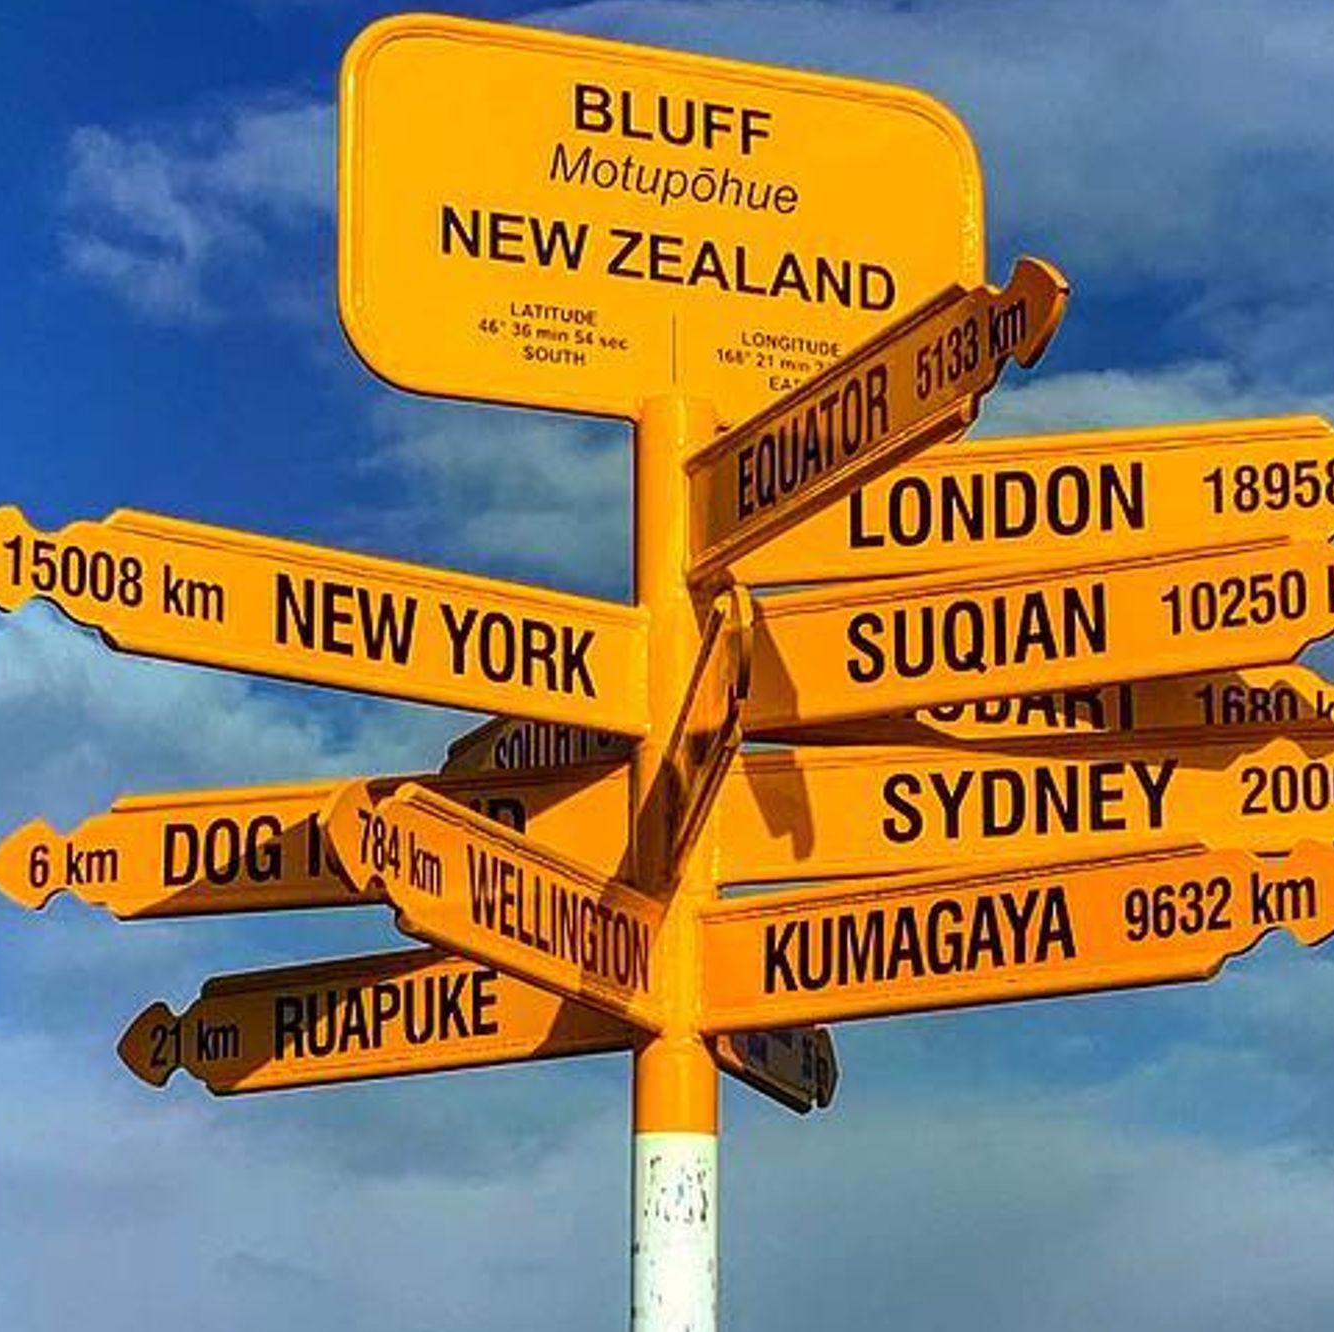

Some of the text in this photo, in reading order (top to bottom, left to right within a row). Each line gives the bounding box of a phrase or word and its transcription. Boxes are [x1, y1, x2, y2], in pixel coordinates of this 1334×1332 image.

[574, 83, 772, 155] BLUFF
[549, 142, 800, 215] Motupōhue
[440, 206, 897, 311] NEW ZEALAND
[510, 302, 597, 326] LATITUDE
[513, 323, 532, 338] 36
[536, 328, 569, 342] min
[599, 336, 629, 350] sec
[741, 331, 841, 357] LONGITUDE
[523, 344, 586, 366] SOUTH
[756, 352, 774, 367] 21
[780, 359, 811, 372] min
[769, 376, 802, 391] EA
[738, 299, 1027, 520] EQUATOR 5133 km
[848, 462, 1145, 549] LONDON
[2, 535, 597, 698] 15008 km NEW YORK
[847, 583, 1108, 685] SUQIAN
[1161, 571, 1307, 636] 10250
[1197, 683, 1299, 726] 1680
[881, 758, 1179, 845] SYDNEY
[28, 845, 50, 888] 6
[65, 838, 119, 887] km
[164, 814, 282, 887] DOG
[358, 807, 402, 880] 784
[407, 831, 442, 897] km
[467, 844, 651, 993] WELLINGTON
[763, 871, 1316, 994] KUMAGAYA 9632 km
[149, 969, 500, 1067] 21 km RUAPUKE
